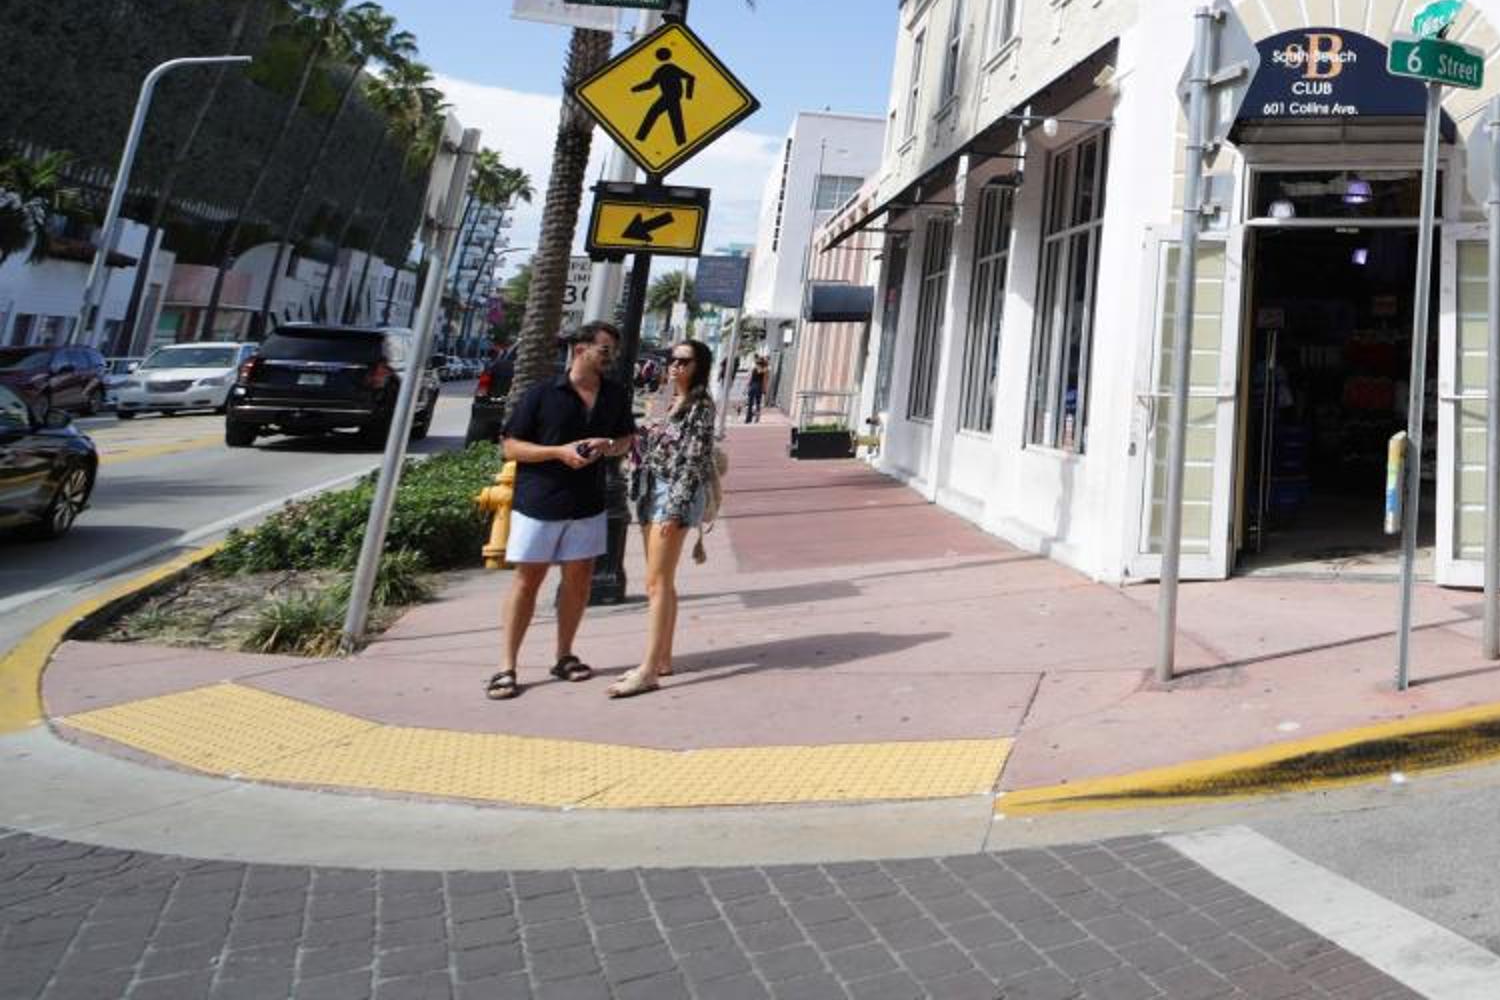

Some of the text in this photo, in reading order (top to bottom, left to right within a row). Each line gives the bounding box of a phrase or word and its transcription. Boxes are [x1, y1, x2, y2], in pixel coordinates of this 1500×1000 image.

[1407, 45, 1479, 83] 6 Street
[1291, 81, 1333, 95] CLUB
[1263, 101, 1360, 115] 601 Collins Ave.
